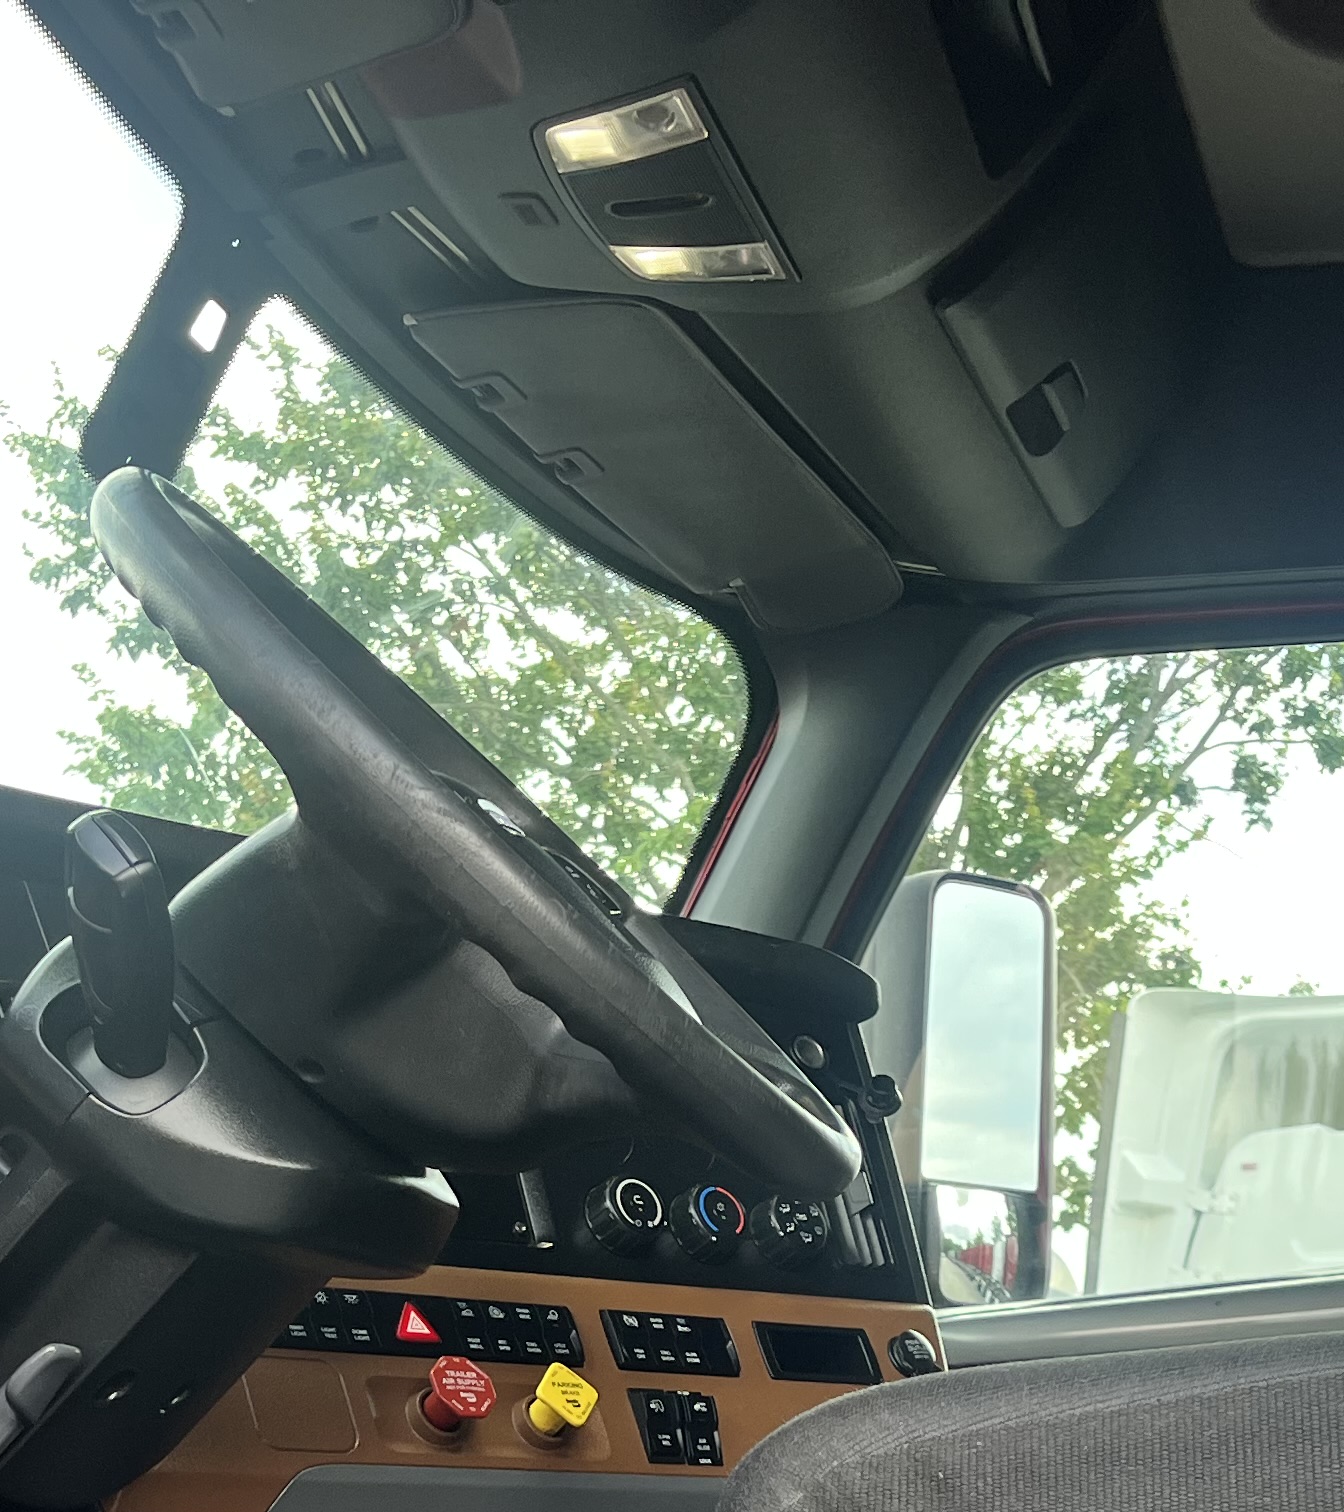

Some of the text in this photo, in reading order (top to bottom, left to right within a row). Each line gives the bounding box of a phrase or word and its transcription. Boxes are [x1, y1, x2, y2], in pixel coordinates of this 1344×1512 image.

[445, 1370, 477, 1378] TRAILER
[442, 1377, 485, 1387] AIR SUPPLY
[551, 1381, 583, 1389] PARKING
